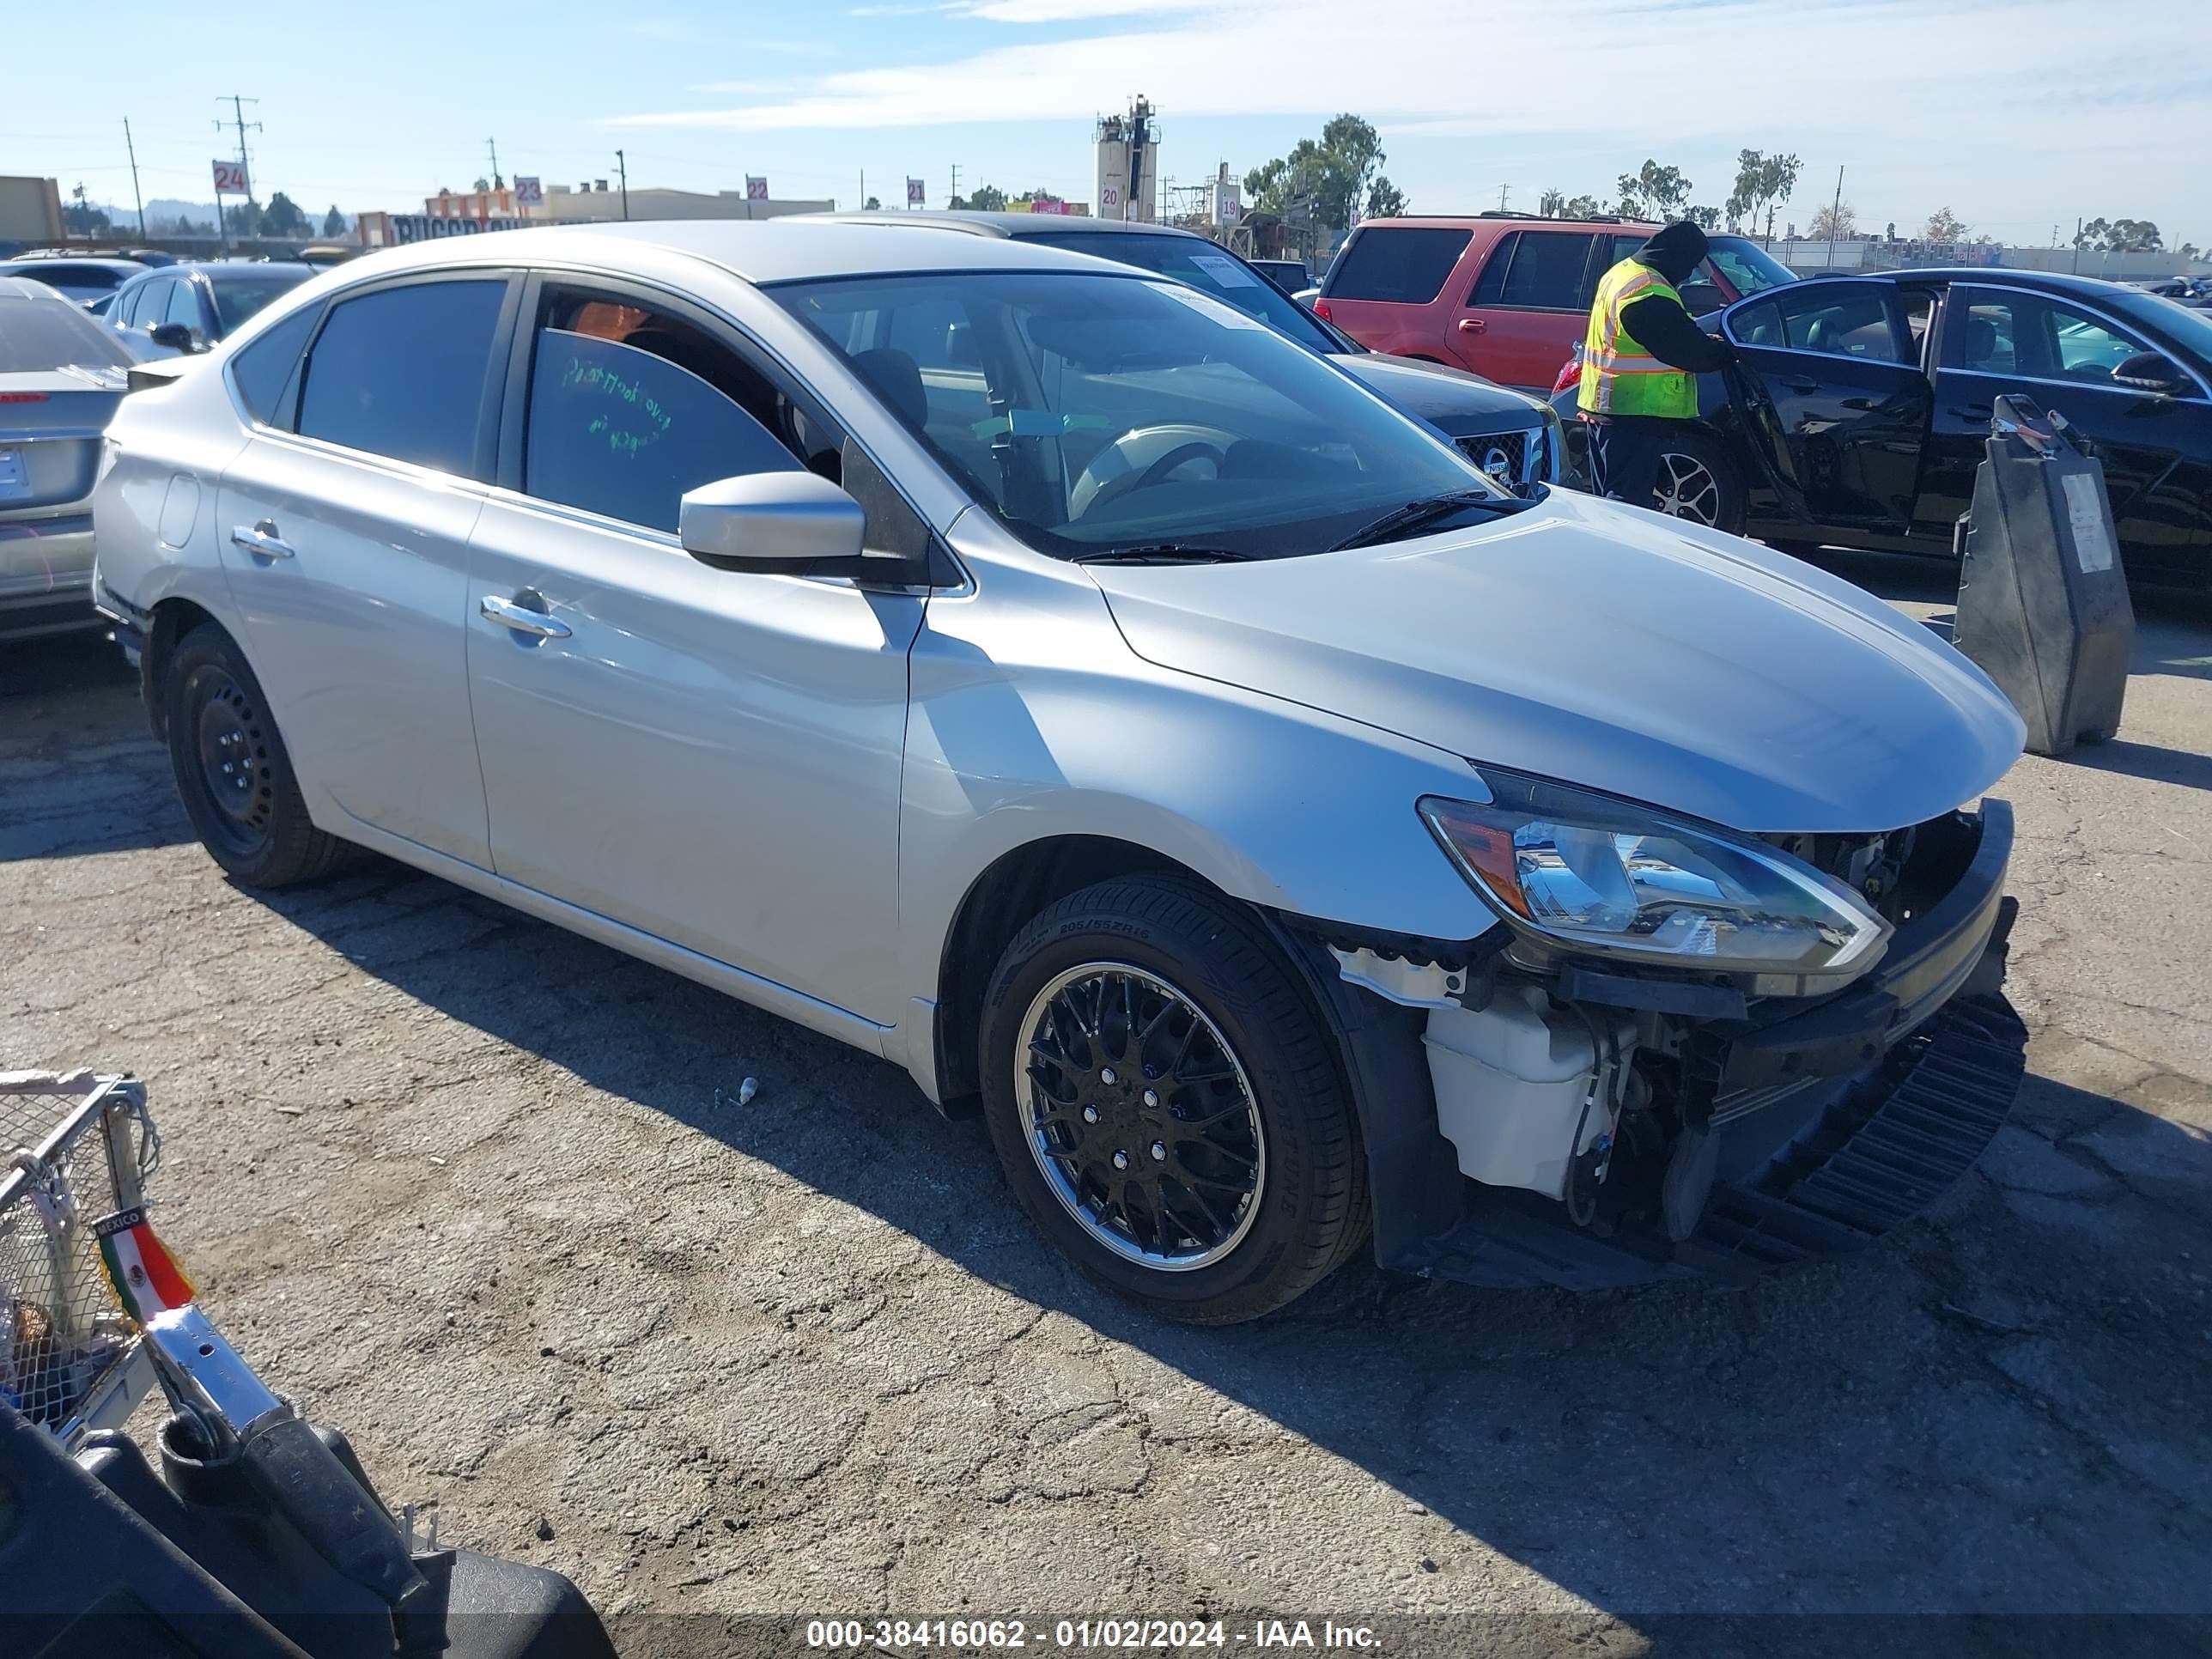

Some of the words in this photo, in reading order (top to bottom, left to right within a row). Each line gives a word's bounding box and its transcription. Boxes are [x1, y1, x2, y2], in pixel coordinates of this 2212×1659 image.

[215, 167, 245, 190] 24
[516, 181, 542, 201] 23
[748, 181, 769, 200] 22
[908, 183, 923, 200] 21
[1103, 189, 1117, 205] 20
[1223, 200, 1236, 216] 19
[1060, 919, 1150, 939] 205/55ZR16
[1266, 1066, 1299, 1218] FORTUNE
[98, 1213, 139, 1235] MEXICO
